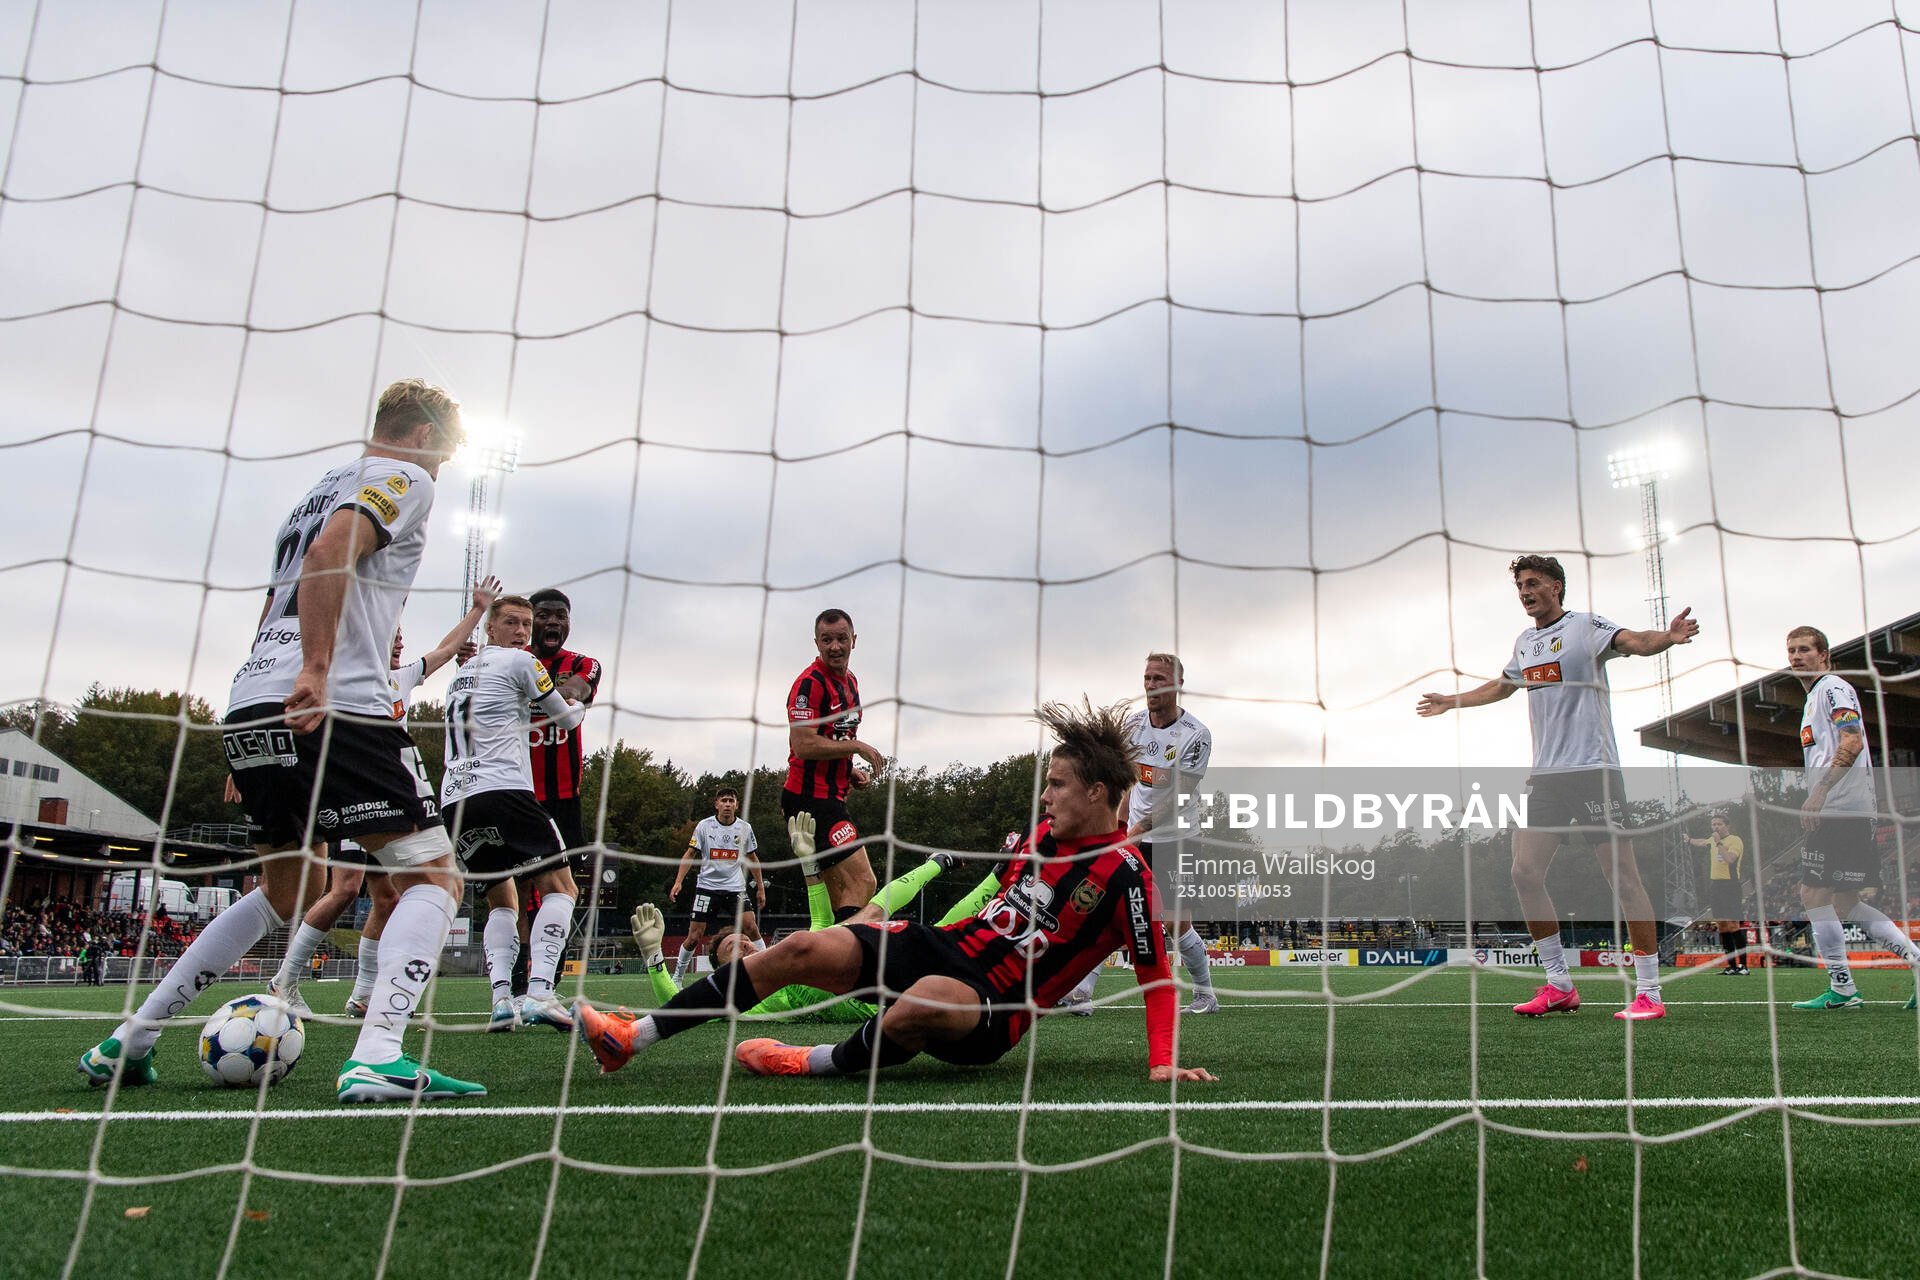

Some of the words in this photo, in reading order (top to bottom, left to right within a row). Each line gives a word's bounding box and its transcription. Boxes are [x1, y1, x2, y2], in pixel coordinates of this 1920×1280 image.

[364, 488, 397, 517] UNIBET
[257, 628, 302, 645] ridge
[341, 800, 390, 816] NORDISK
[422, 799, 438, 818] 22
[343, 809, 405, 825] GRUNDTEKNIK
[712, 849, 737, 858] BRA
[1128, 887, 1151, 954] stadium
[1300, 950, 1343, 962] weber
[1366, 951, 1423, 964] DAHL
